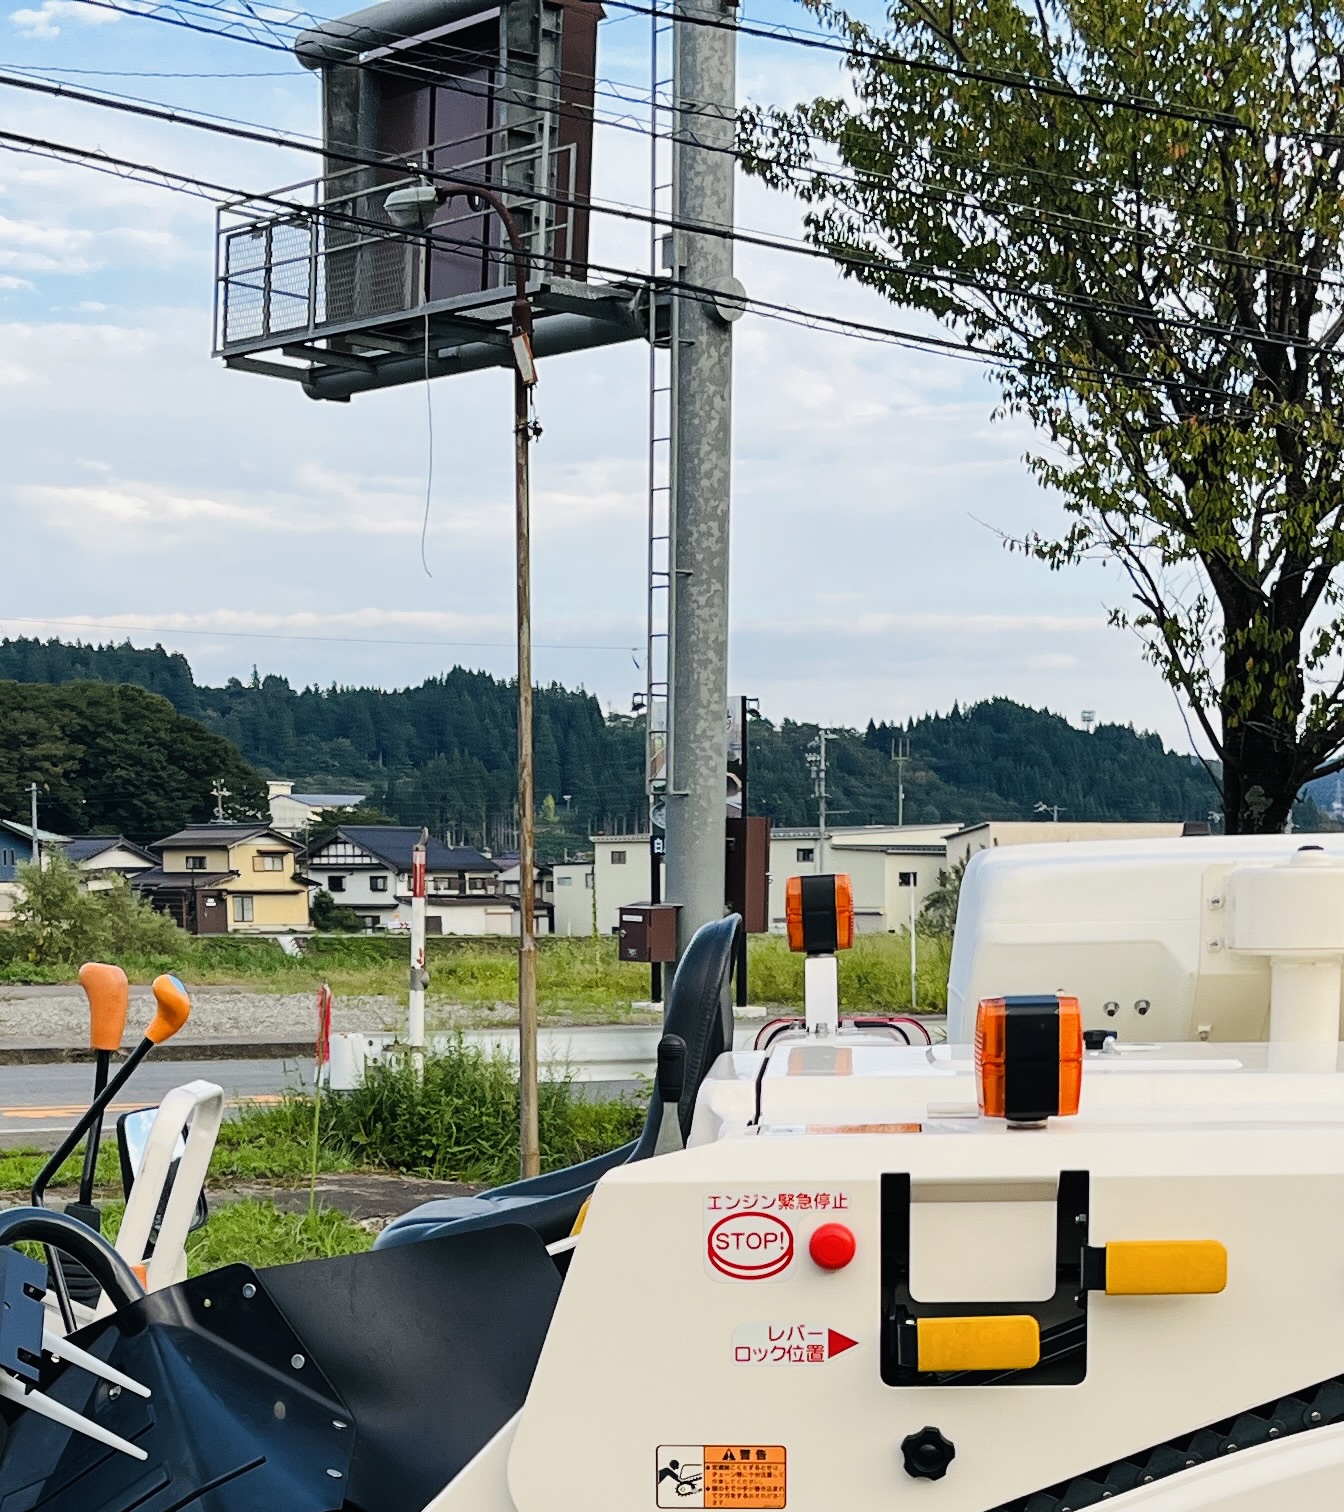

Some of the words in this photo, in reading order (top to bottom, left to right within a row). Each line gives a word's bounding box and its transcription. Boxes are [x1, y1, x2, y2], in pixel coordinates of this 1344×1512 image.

[707, 1192, 849, 1210] エンジン緊急停止
[716, 1231, 785, 1250] STOP!
[768, 1324, 824, 1342] レバー
[735, 1344, 825, 1363] ロック位置
